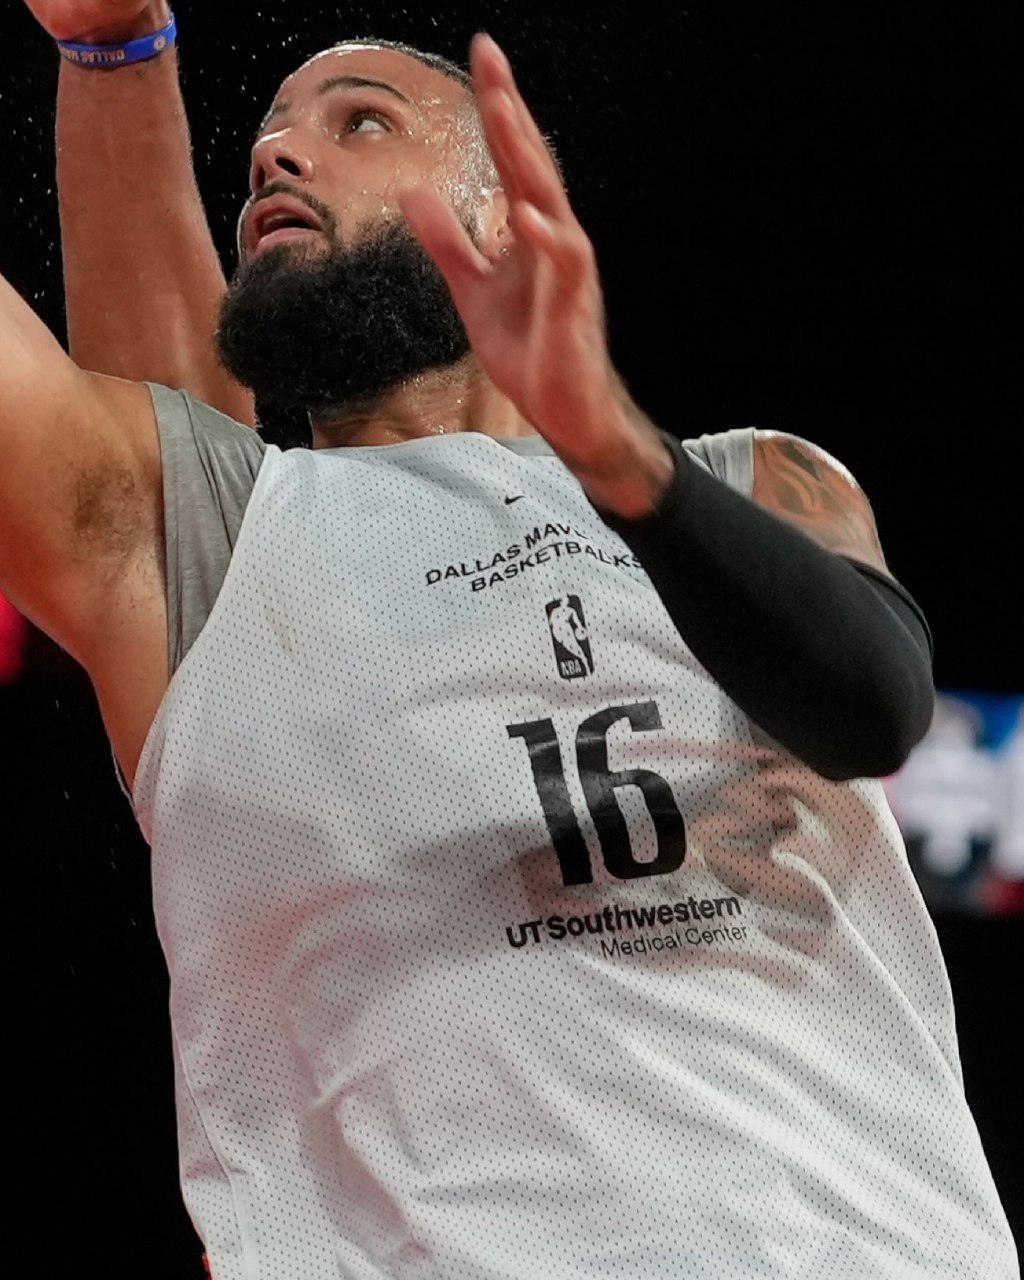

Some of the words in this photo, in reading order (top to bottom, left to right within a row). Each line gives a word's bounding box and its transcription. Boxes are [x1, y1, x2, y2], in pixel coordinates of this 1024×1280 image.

[425, 544, 521, 586] DALLAS
[560, 658, 582, 676] NBA
[506, 700, 687, 886] 16
[506, 921, 543, 948] UT
[547, 896, 742, 940] Southwestern
[600, 932, 681, 959] Medical
[684, 926, 747, 946] Center
